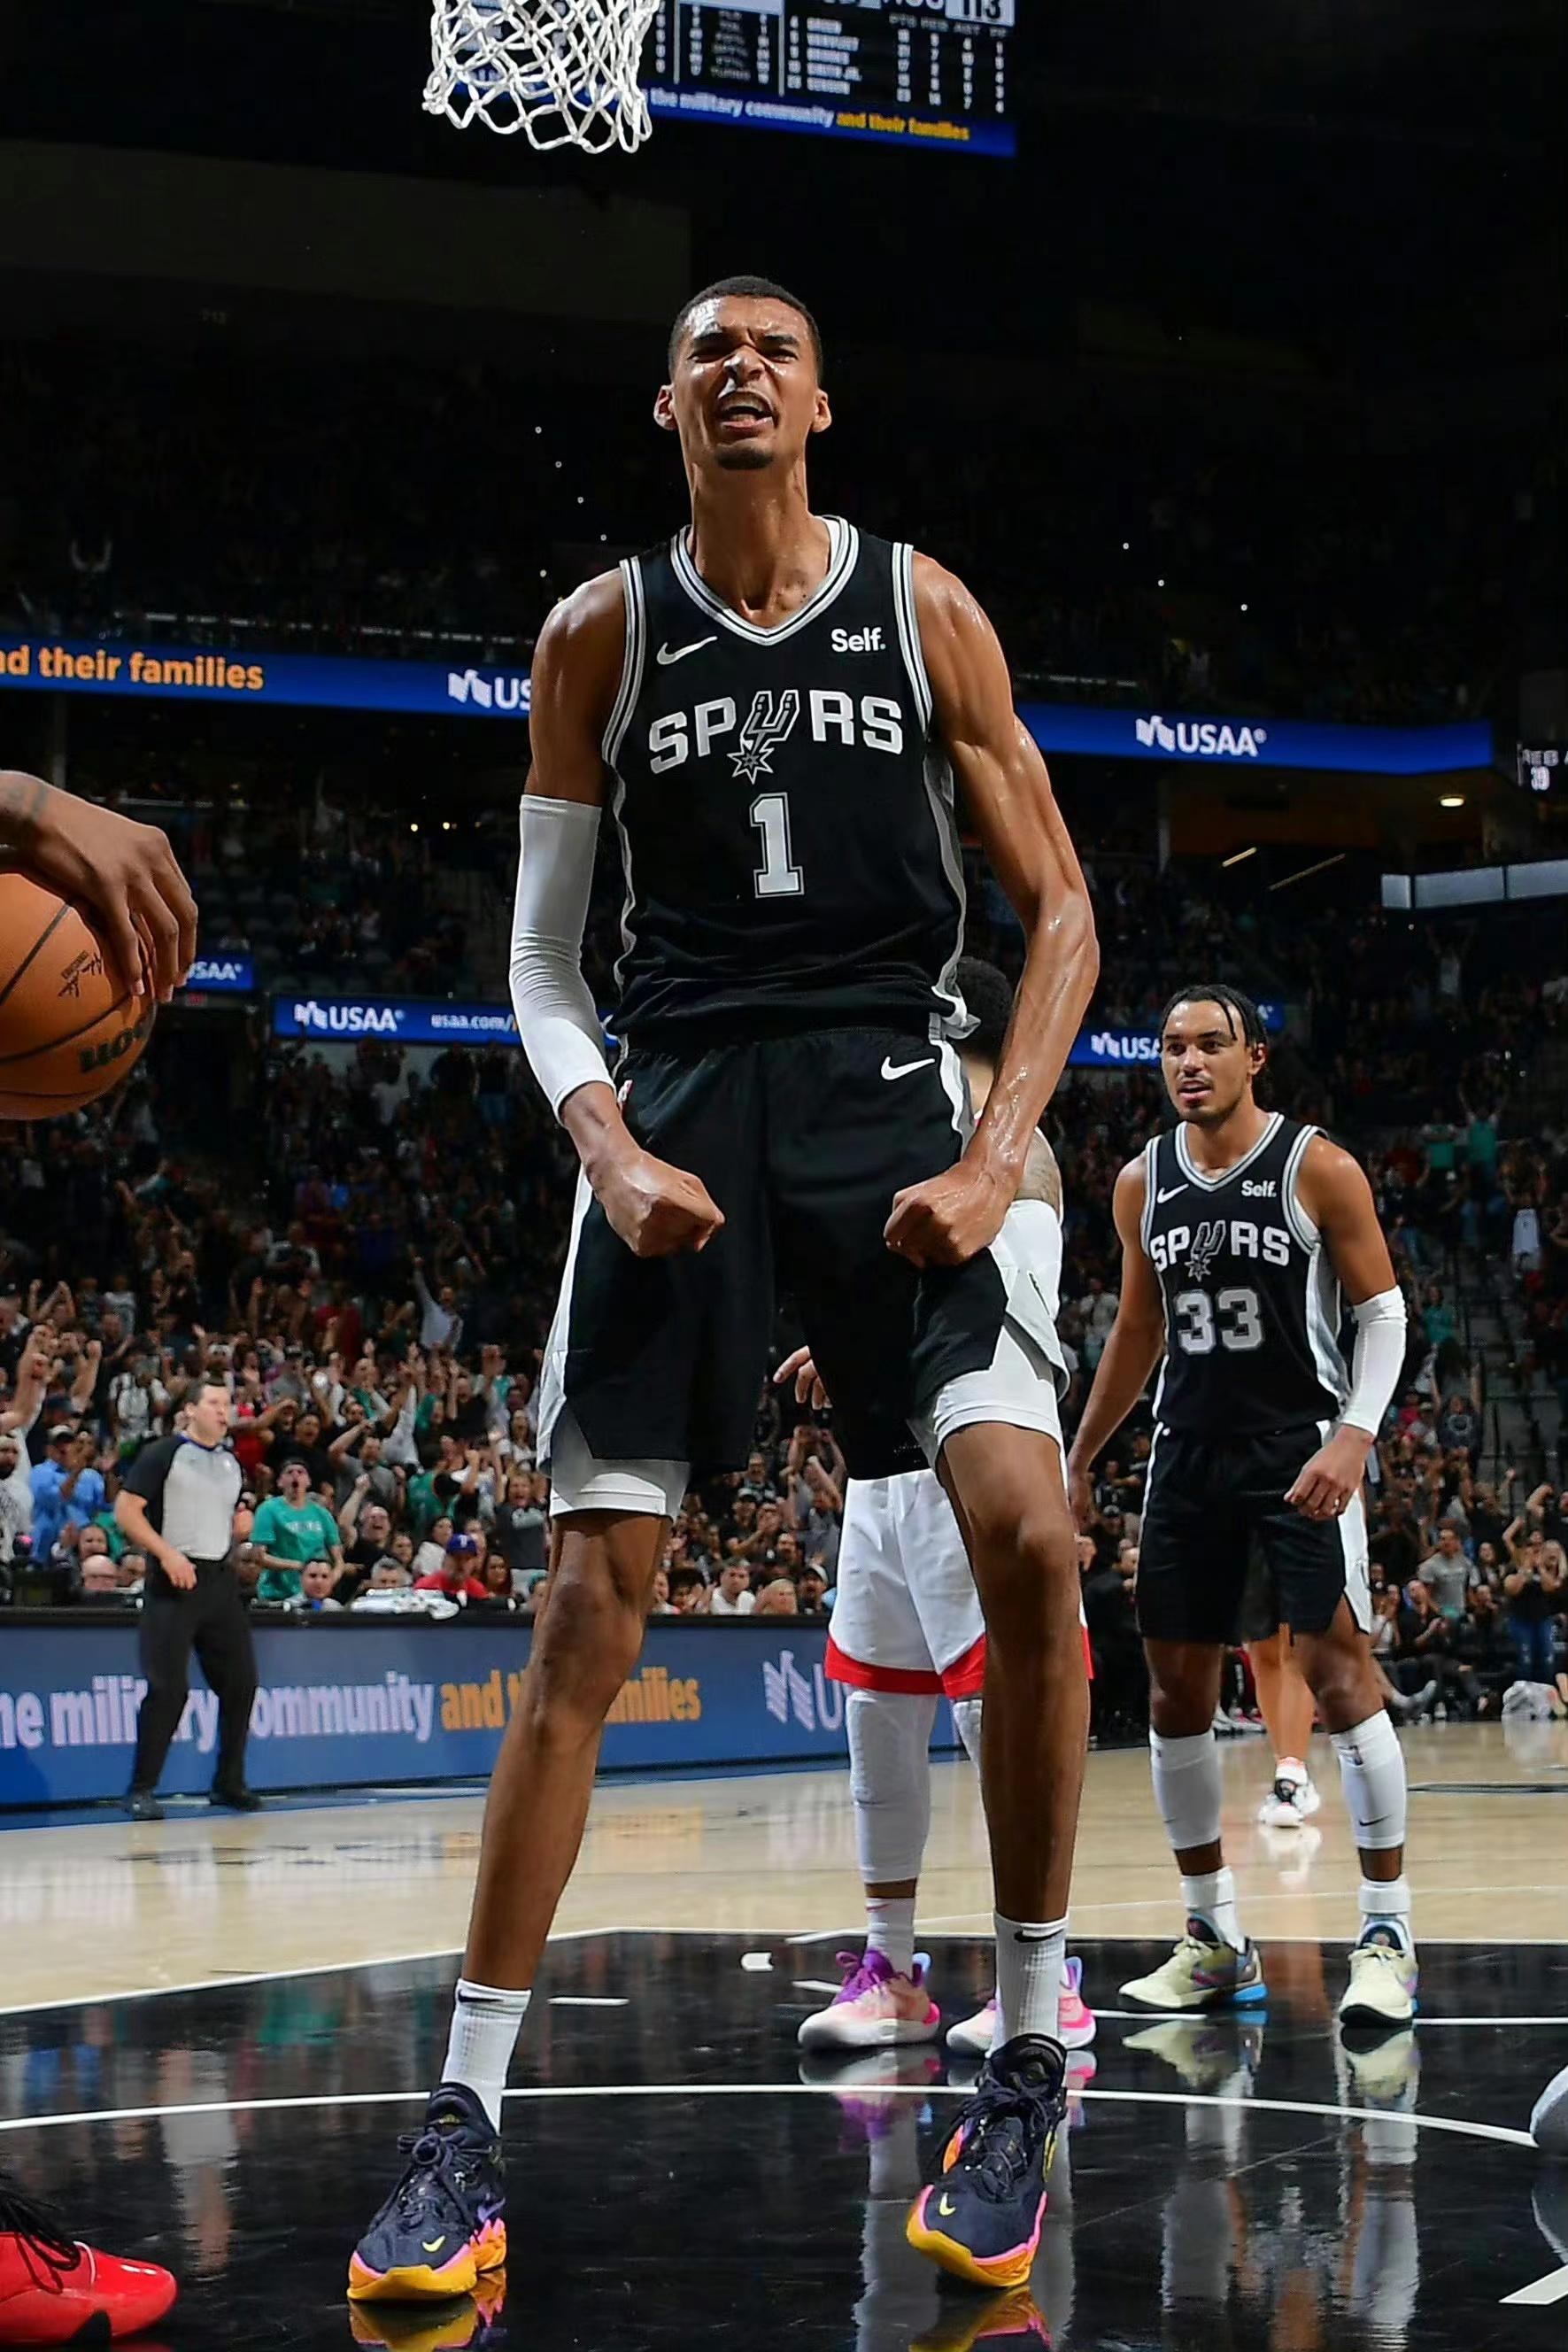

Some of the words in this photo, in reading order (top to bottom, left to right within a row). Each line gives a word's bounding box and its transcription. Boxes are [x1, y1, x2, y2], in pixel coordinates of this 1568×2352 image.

[39, 646, 121, 681] their
[129, 651, 264, 691] families
[750, 792, 805, 899] 1
[1174, 1287, 1263, 1355] 33
[249, 1669, 434, 1743] ommunity
[440, 1668, 506, 1730] and
